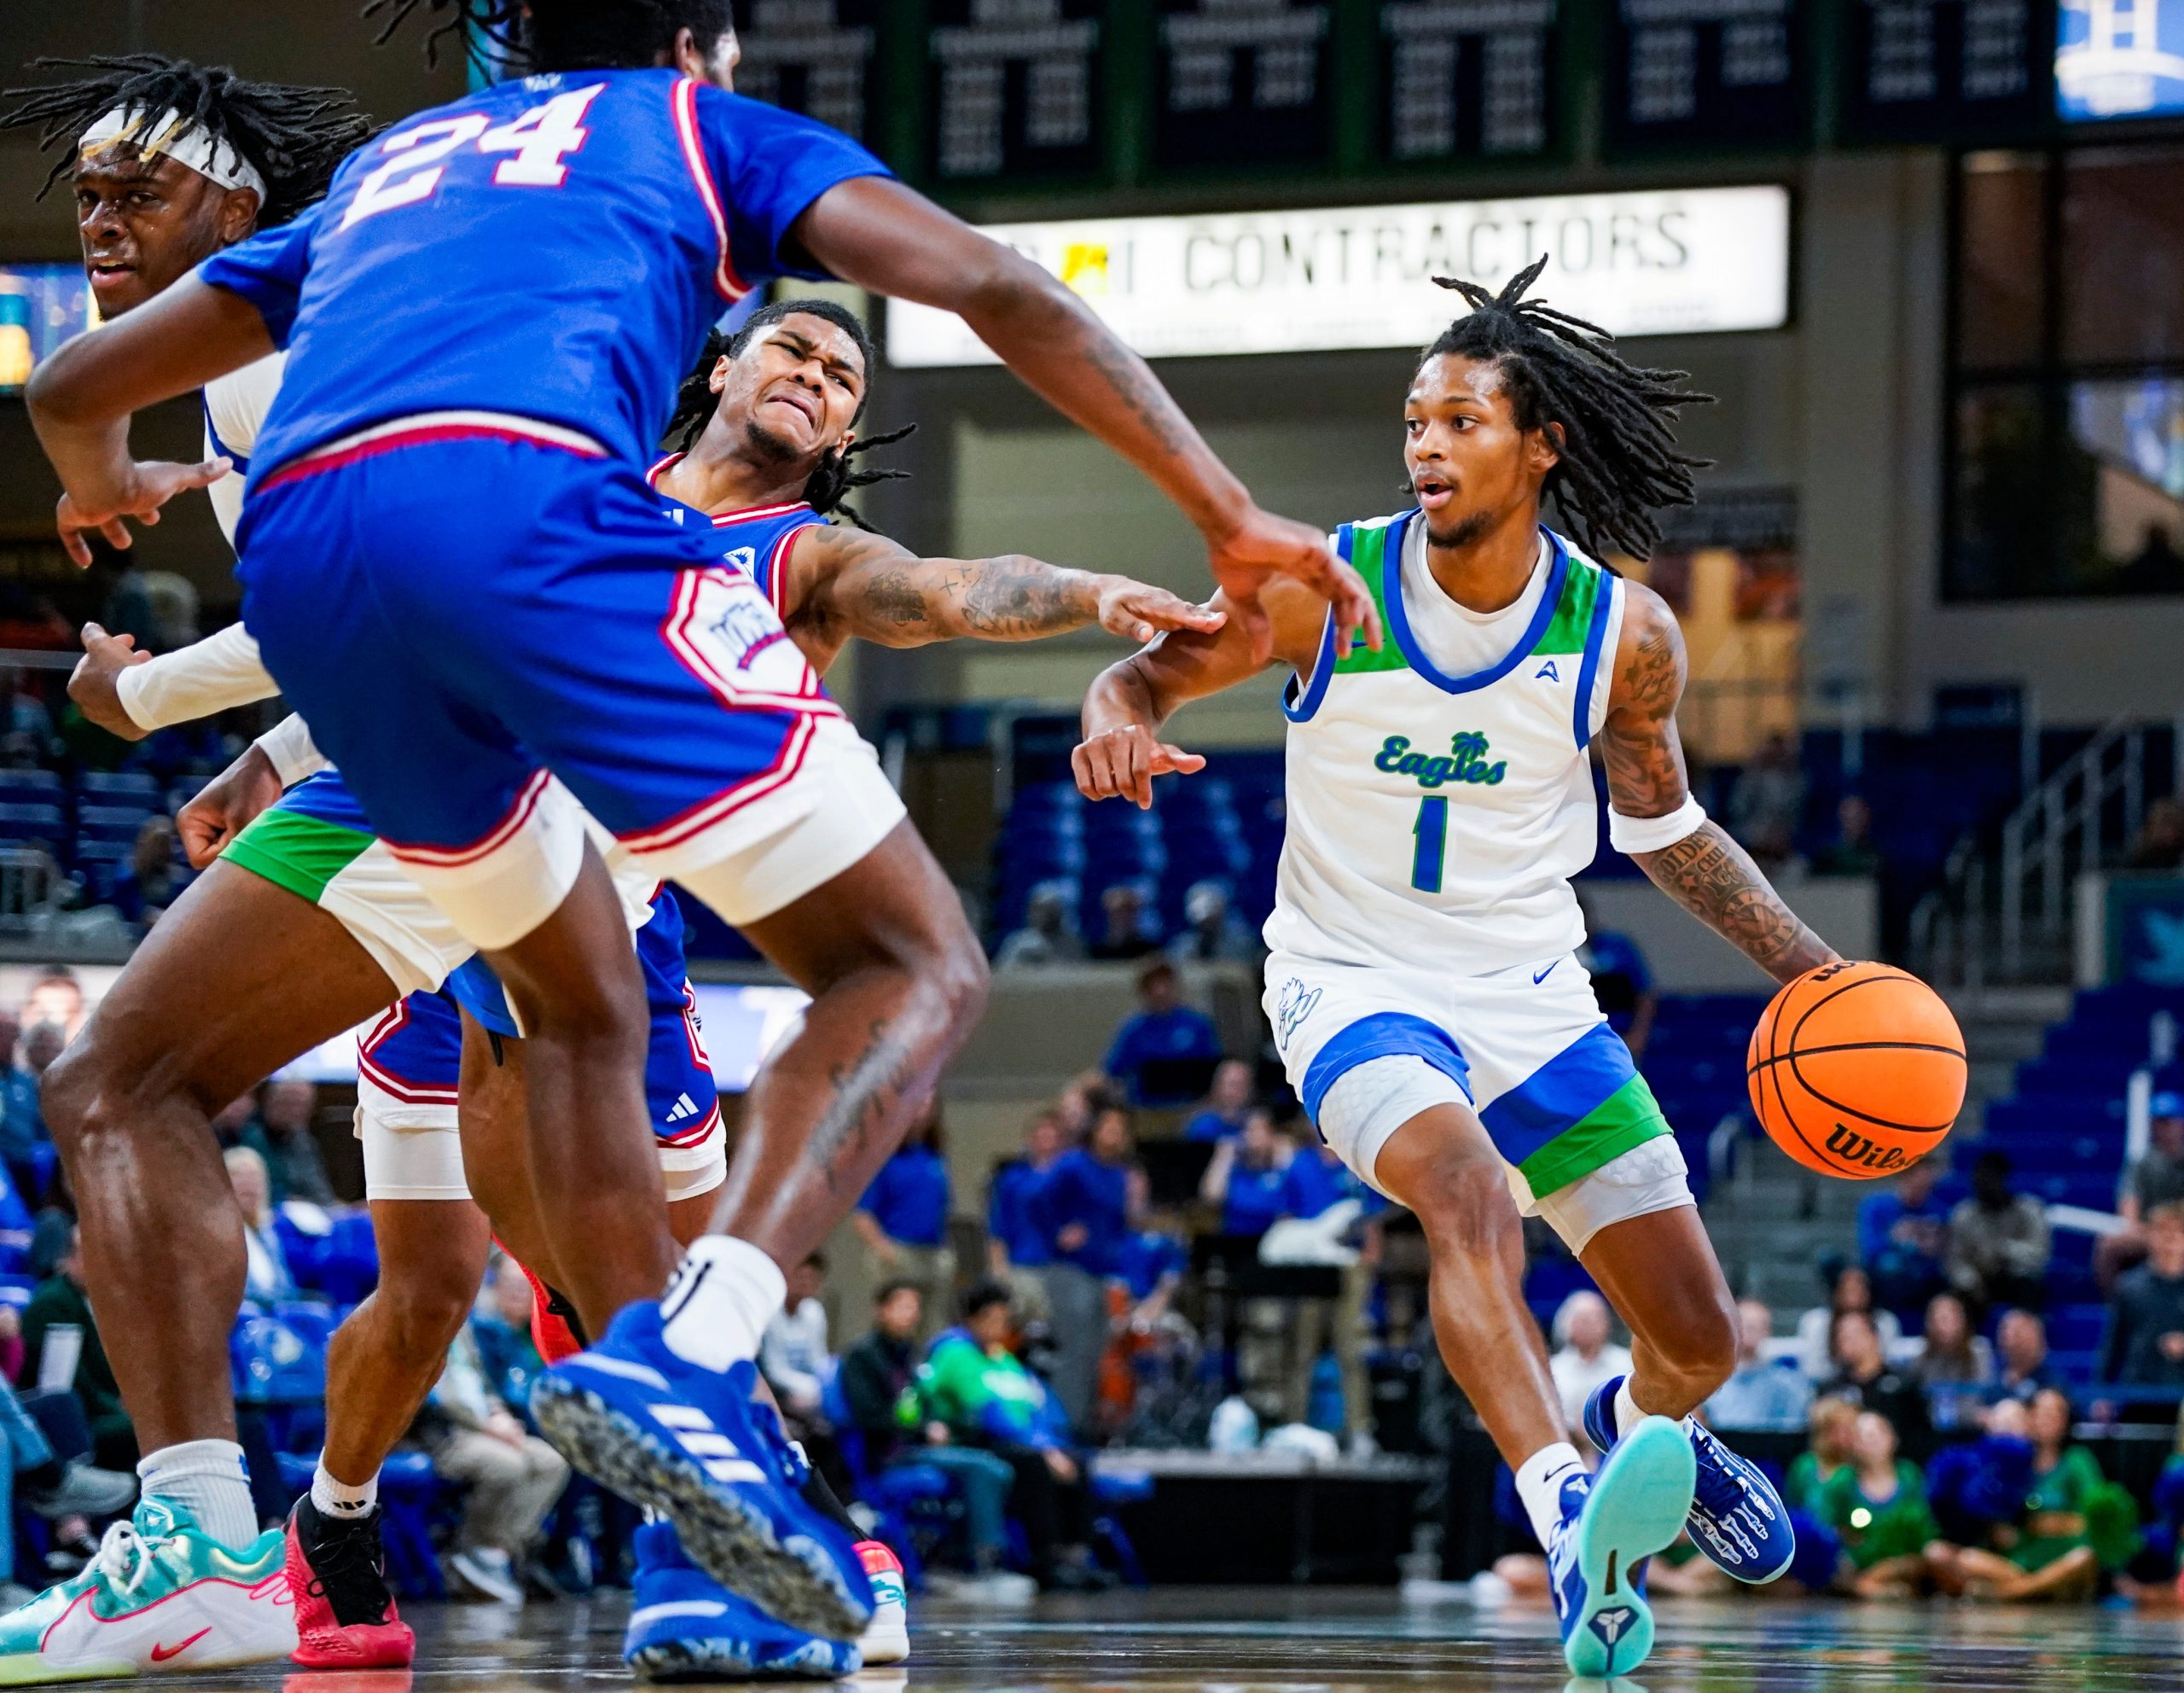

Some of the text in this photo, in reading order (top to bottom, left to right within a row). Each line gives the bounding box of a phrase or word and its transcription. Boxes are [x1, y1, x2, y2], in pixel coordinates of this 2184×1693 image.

[334, 81, 611, 233] 24
[1186, 209, 1691, 292] CONTRACTORS
[1374, 730, 1508, 788] Eagles
[1411, 794, 1449, 893] 1
[1826, 1122, 1926, 1169] Wils
